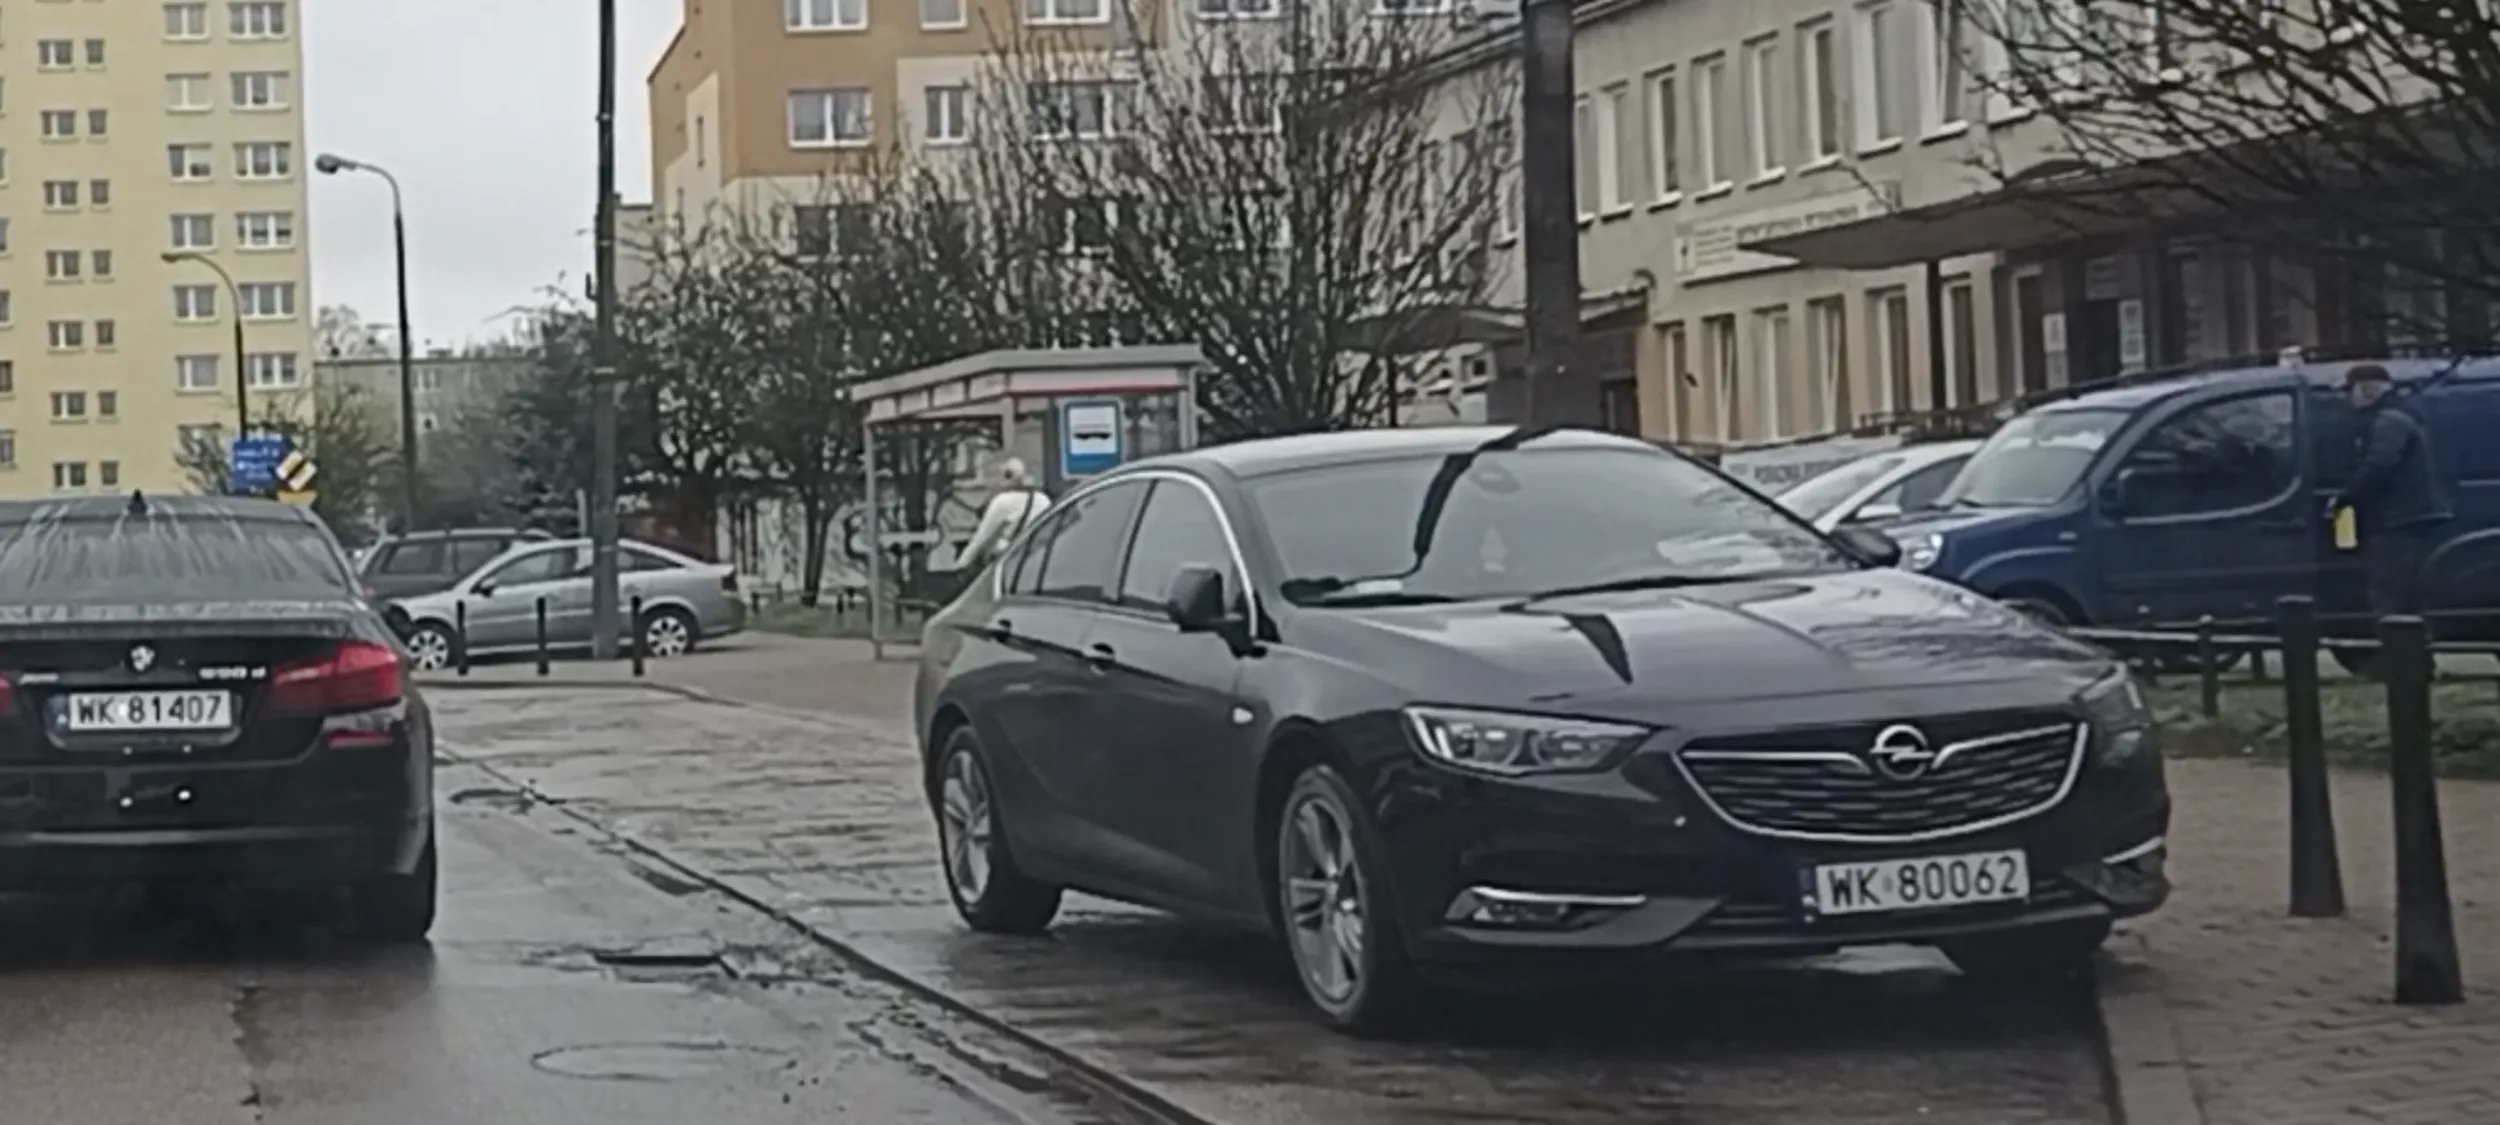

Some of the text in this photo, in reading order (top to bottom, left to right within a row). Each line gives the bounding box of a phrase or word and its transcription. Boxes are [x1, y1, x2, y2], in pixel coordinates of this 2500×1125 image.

[76, 695, 222, 725] WK 81407
[1827, 856, 2018, 907] WK 80062
